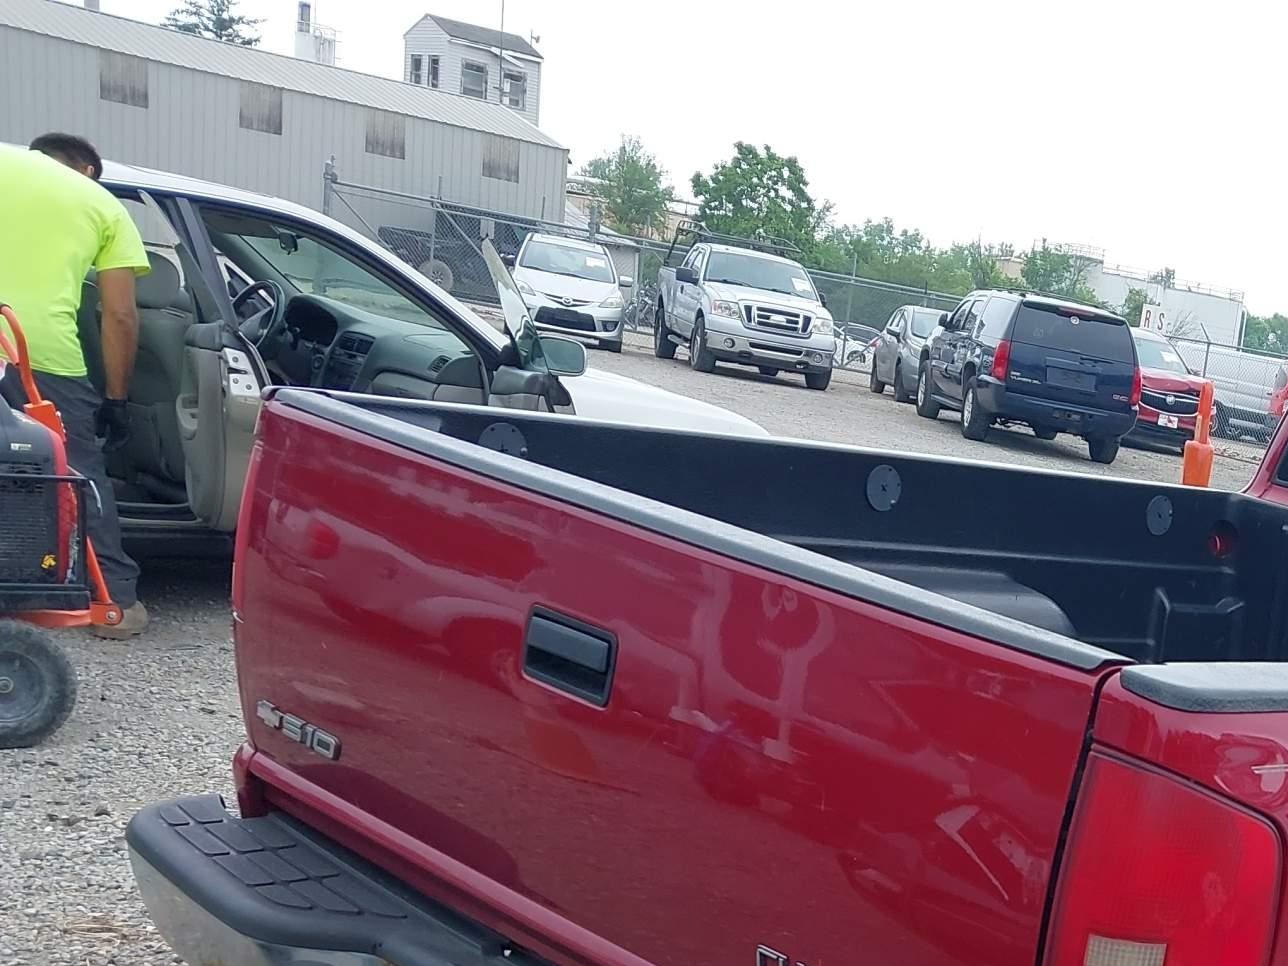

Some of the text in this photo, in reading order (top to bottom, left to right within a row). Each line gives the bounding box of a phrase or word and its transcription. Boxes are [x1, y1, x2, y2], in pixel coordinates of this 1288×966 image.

[1144, 310, 1165, 330] R S
[281, 711, 341, 760] S10
